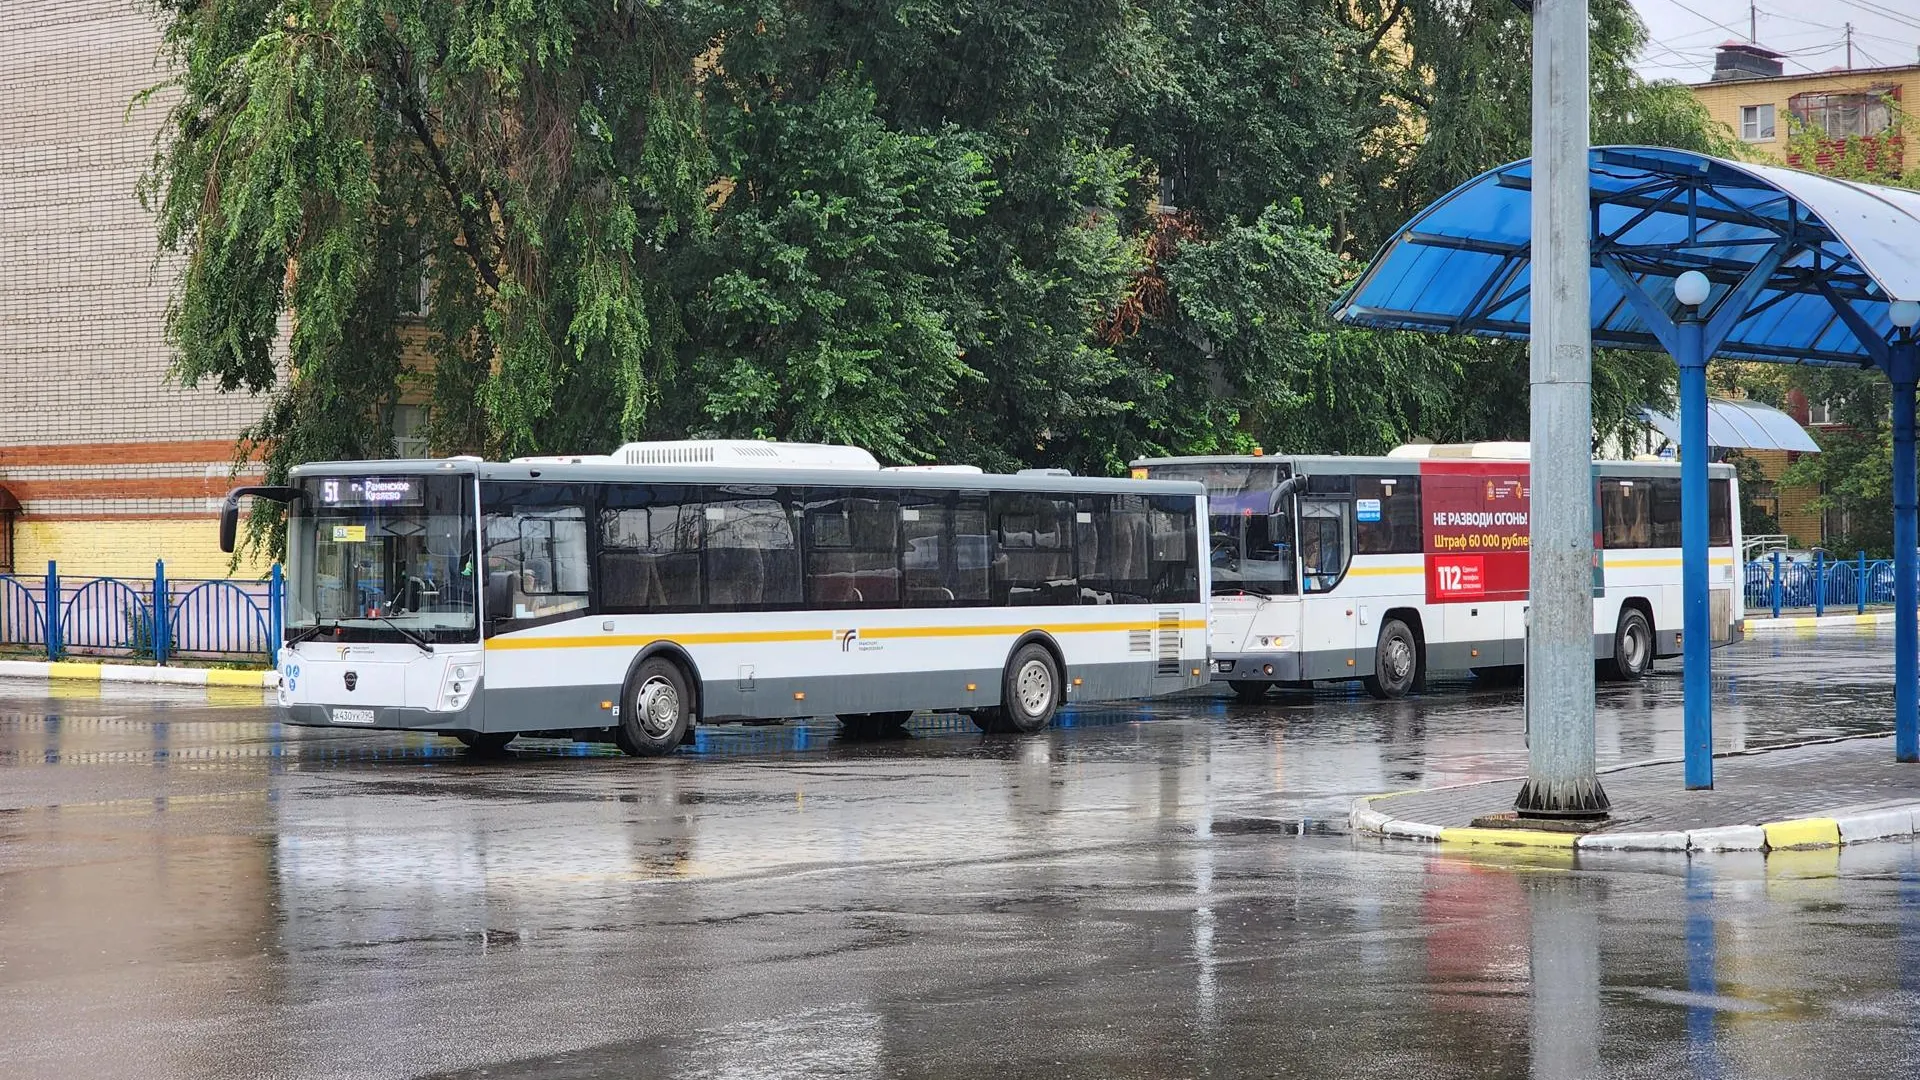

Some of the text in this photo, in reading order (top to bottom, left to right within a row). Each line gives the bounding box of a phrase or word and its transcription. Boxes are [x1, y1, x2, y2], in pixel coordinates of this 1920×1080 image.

[324, 481, 340, 503] 51
[1433, 512, 1528, 527] НЕ РАЗВОДИ ОГОНЬ!
[1434, 534, 1467, 551] Штраф
[1469, 535, 1480, 547] 60
[1482, 534, 1500, 547] 000
[1437, 565, 1462, 591] 112
